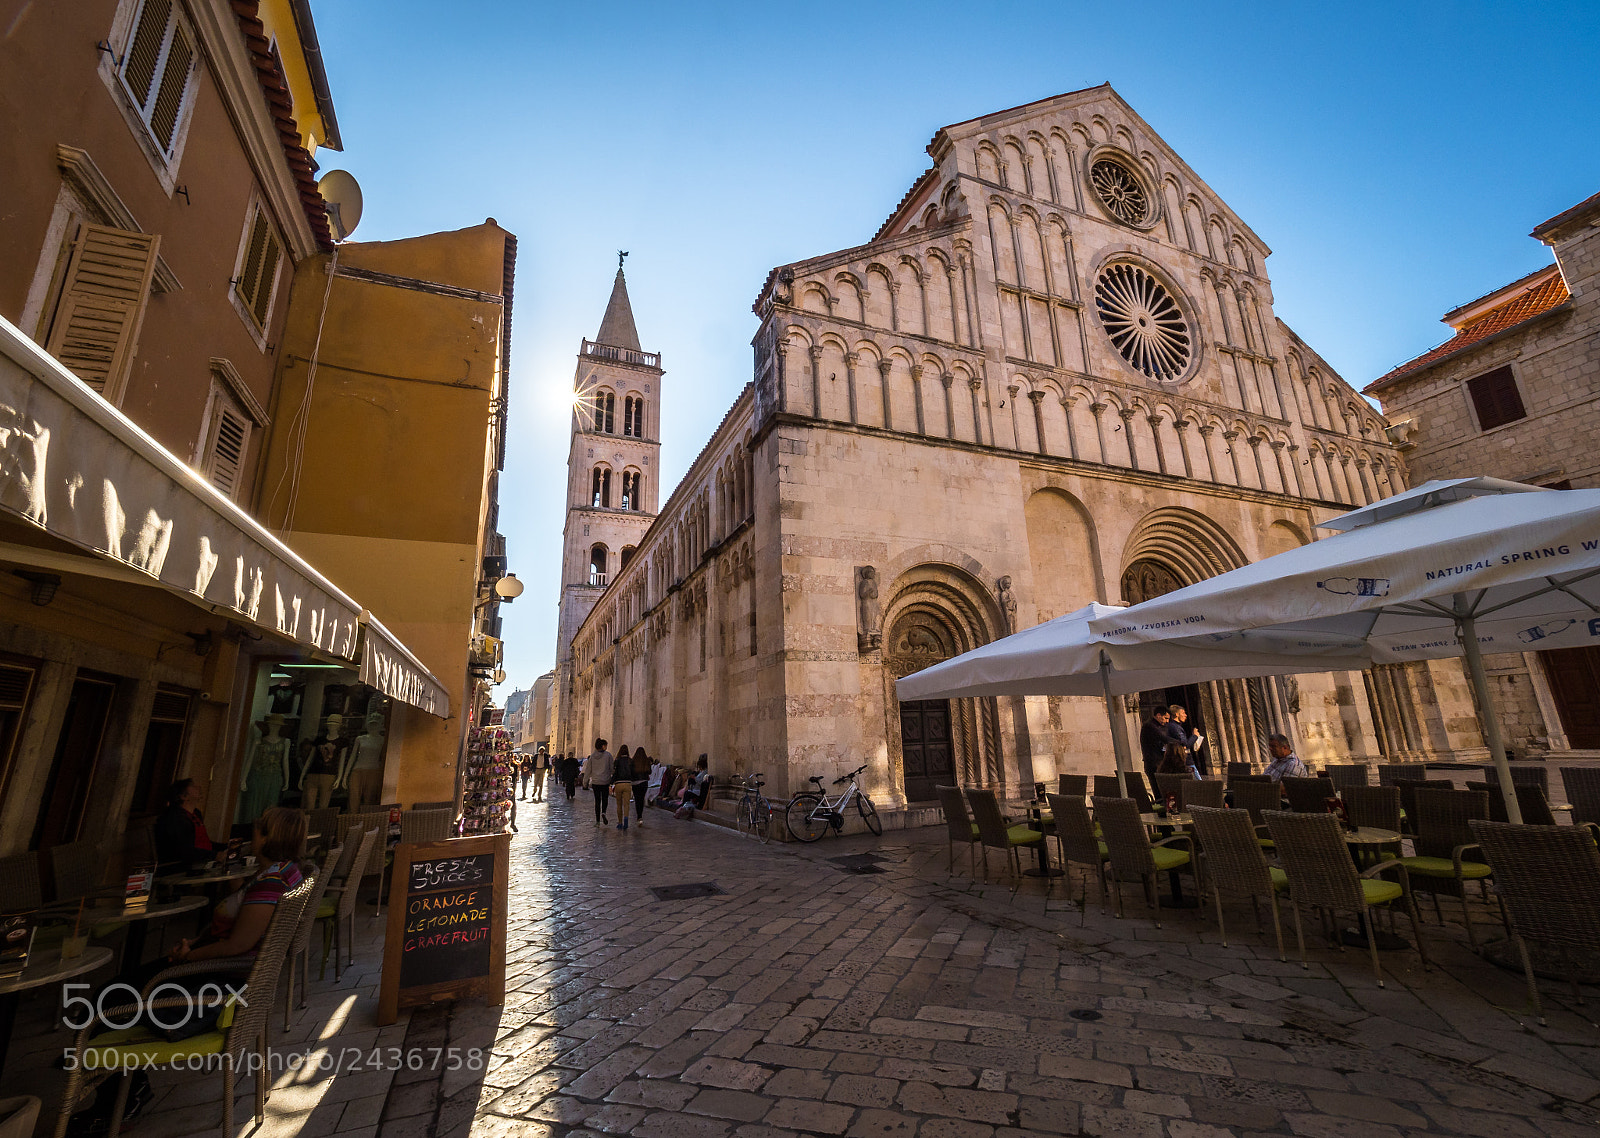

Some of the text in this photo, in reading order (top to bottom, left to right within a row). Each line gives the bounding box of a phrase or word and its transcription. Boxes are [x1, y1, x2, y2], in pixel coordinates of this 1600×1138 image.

[1426, 559, 1492, 581] NATURAL
[1501, 545, 1570, 565] SPRING
[1102, 614, 1206, 638] PRIRODNA IZVORSKA VODA
[412, 857, 477, 877] FRESH
[414, 868, 484, 889] JUICES
[410, 891, 478, 915] ORANGE
[407, 907, 489, 933] LEMONADE
